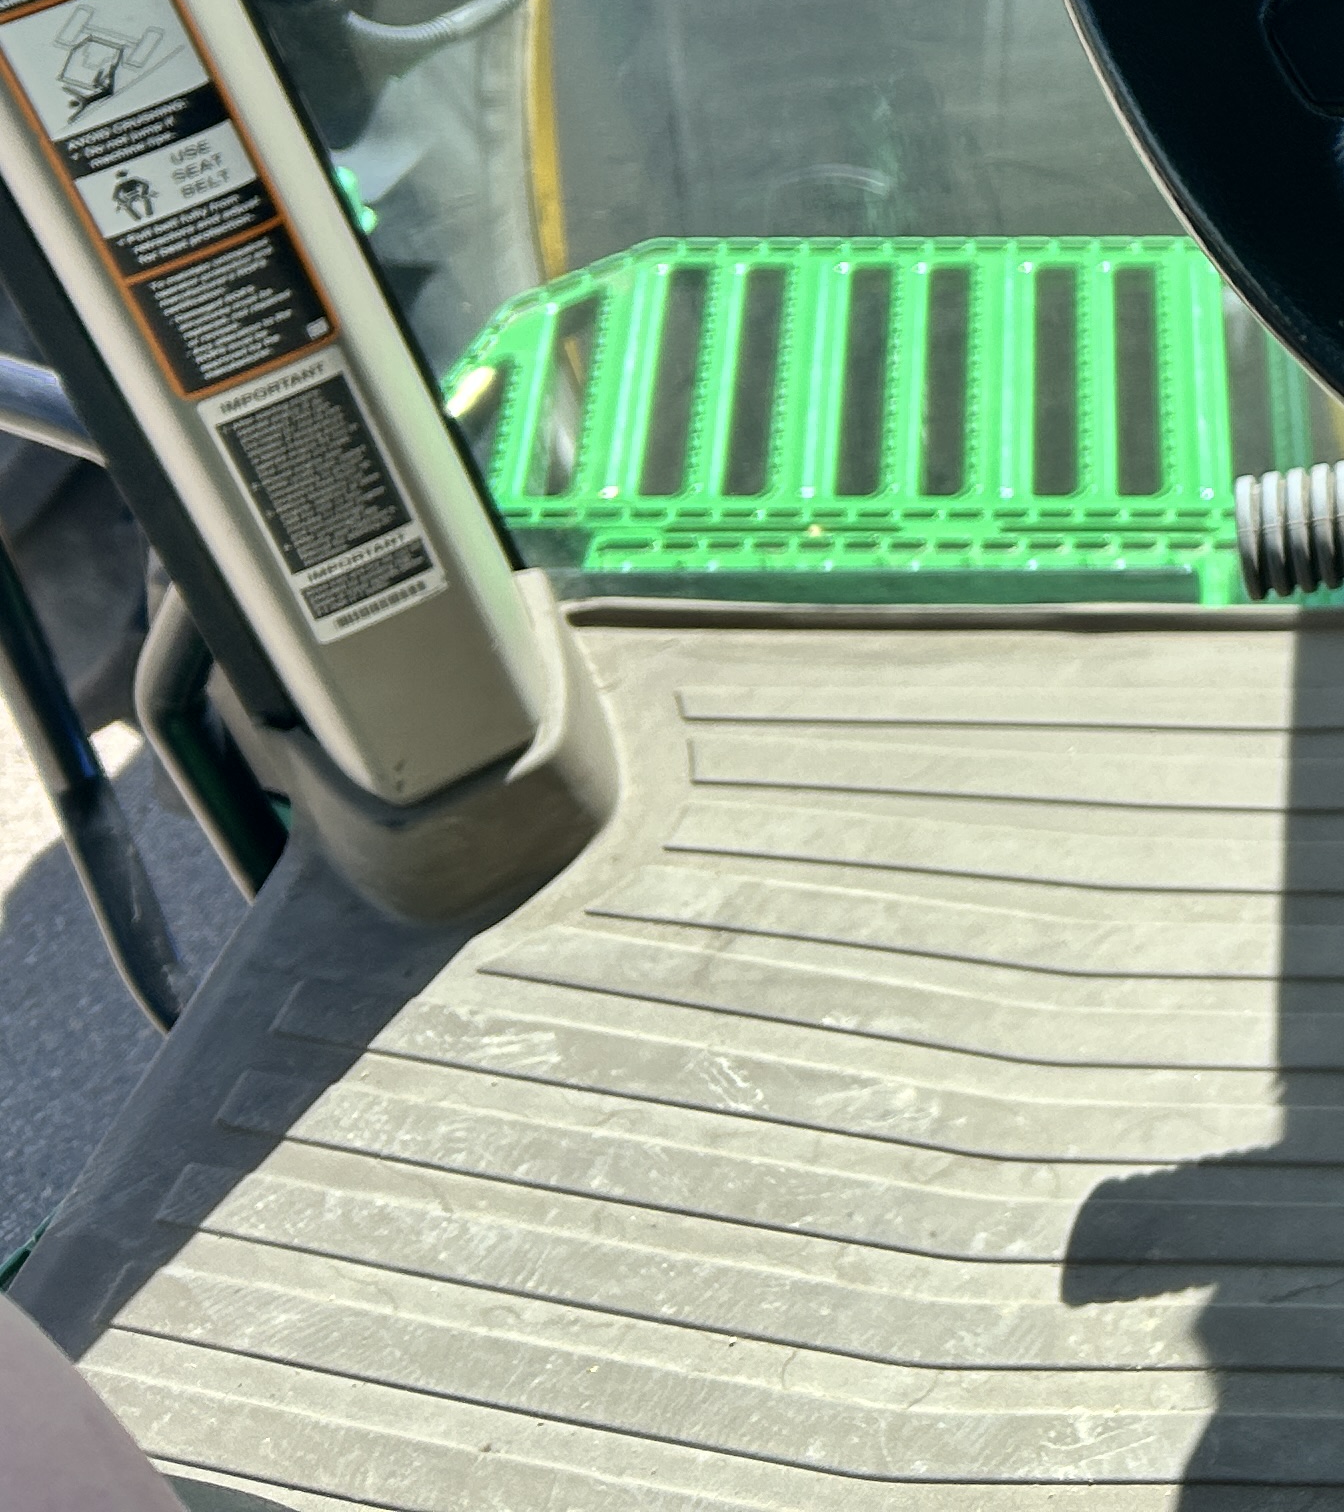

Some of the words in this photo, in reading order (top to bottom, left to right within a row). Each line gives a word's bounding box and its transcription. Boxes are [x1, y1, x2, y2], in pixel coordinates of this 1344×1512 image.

[168, 139, 211, 165] USE
[170, 152, 225, 183] SEAT
[179, 168, 232, 199] BELT
[219, 361, 326, 414] IMPORTANT
[305, 533, 407, 582] IMPORTANT
